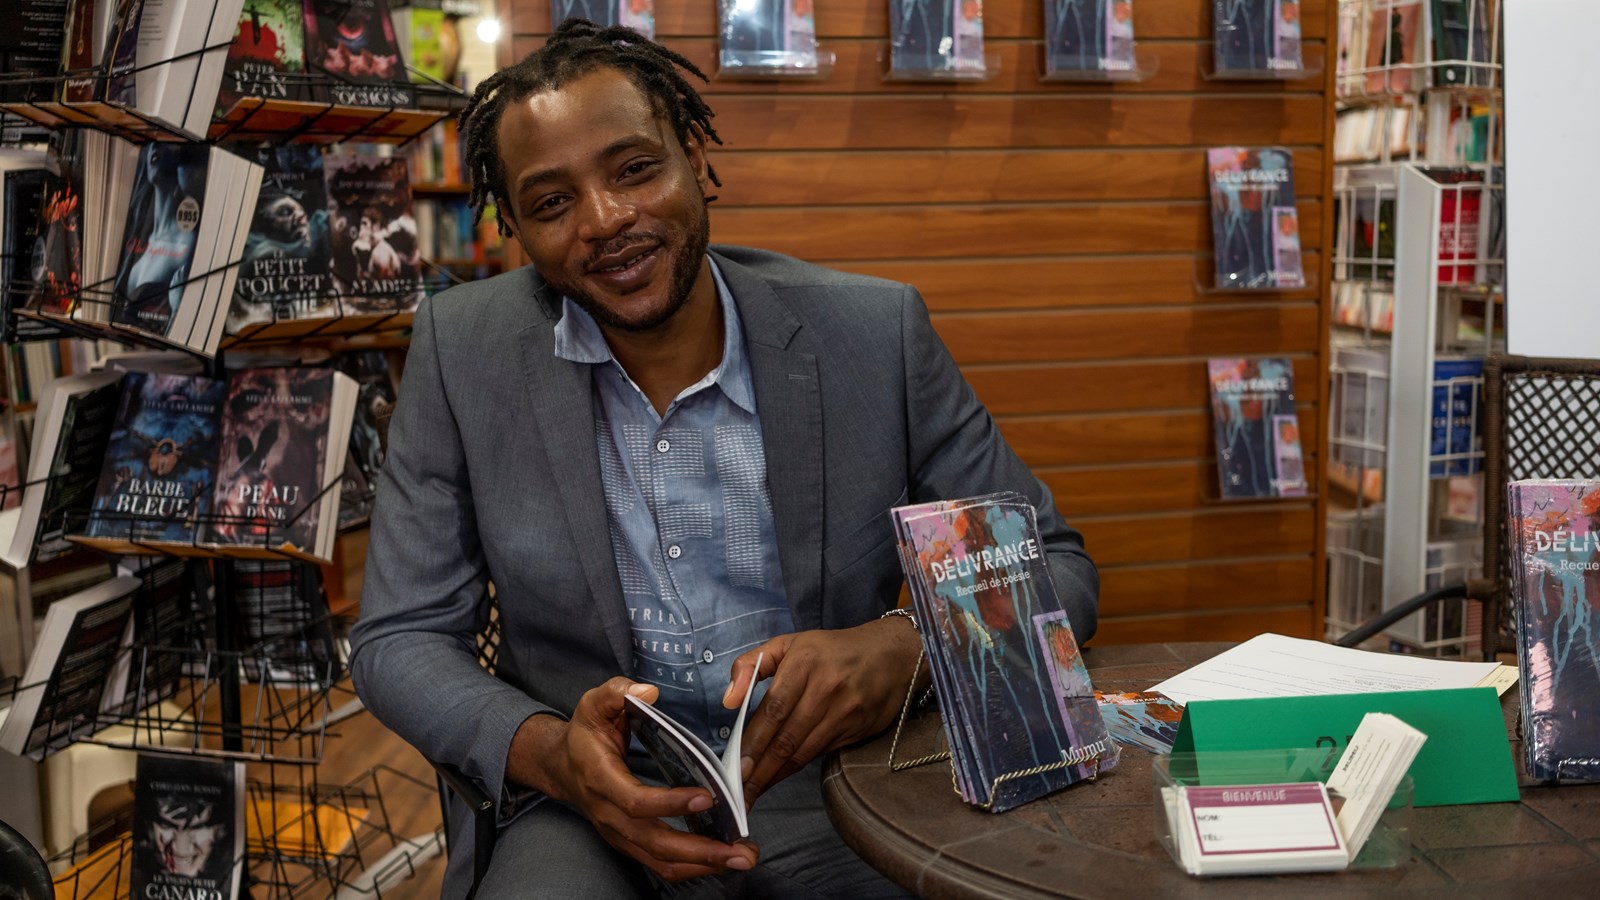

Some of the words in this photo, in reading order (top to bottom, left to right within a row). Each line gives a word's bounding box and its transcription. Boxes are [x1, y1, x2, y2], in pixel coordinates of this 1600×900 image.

[244, 62, 275, 74] PETER
[235, 70, 287, 97] PAN
[253, 257, 308, 276] PETIT
[238, 274, 326, 297] POUCET
[128, 477, 185, 498] BARBE
[238, 484, 300, 506] PEAU
[116, 494, 190, 519] BLEUE
[930, 538, 1039, 583] DÉLIVRANCE
[955, 580, 989, 598] Recueil
[989, 578, 1002, 588] de
[1002, 570, 1031, 588] poésie
[656, 667, 694, 683] SIX
[1060, 740, 1107, 761] Mumu
[1222, 789, 1287, 803] BIENVENUE
[145, 882, 223, 900] CANARD
